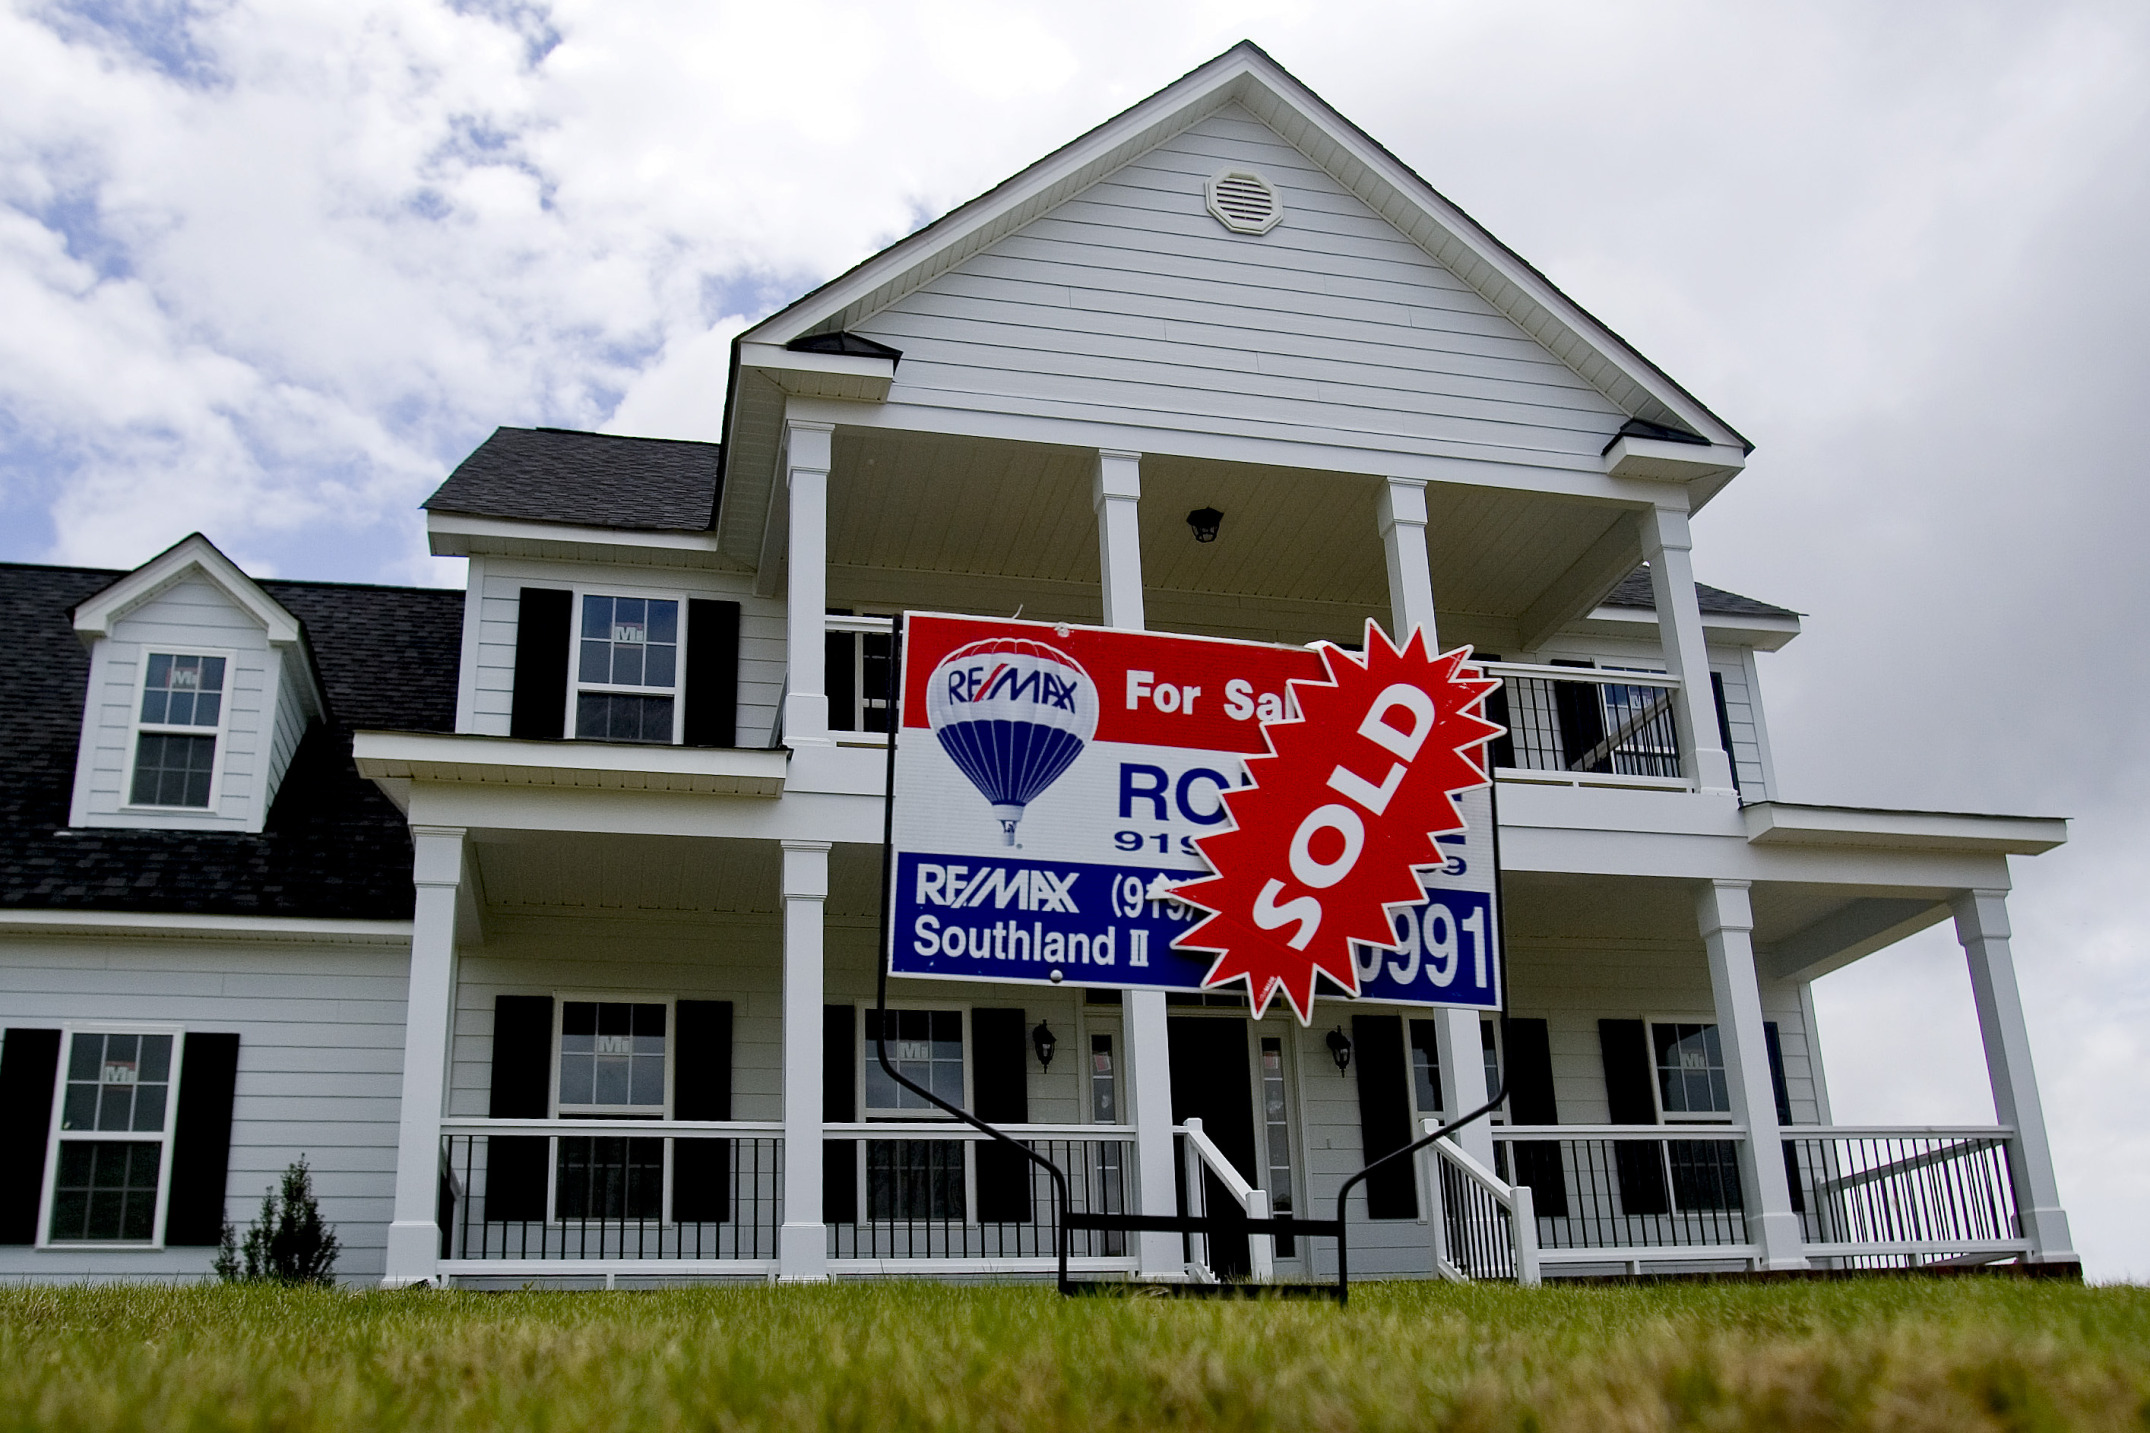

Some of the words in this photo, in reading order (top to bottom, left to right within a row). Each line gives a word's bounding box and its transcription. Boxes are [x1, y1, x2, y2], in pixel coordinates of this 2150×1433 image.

[948, 663, 1077, 714] RE/MAX
[1126, 669, 1201, 715] For
[1223, 678, 1296, 721] Sal
[1253, 683, 1435, 951] SOLD
[916, 863, 1080, 914] RE/MAX
[914, 915, 1115, 966] Southland
